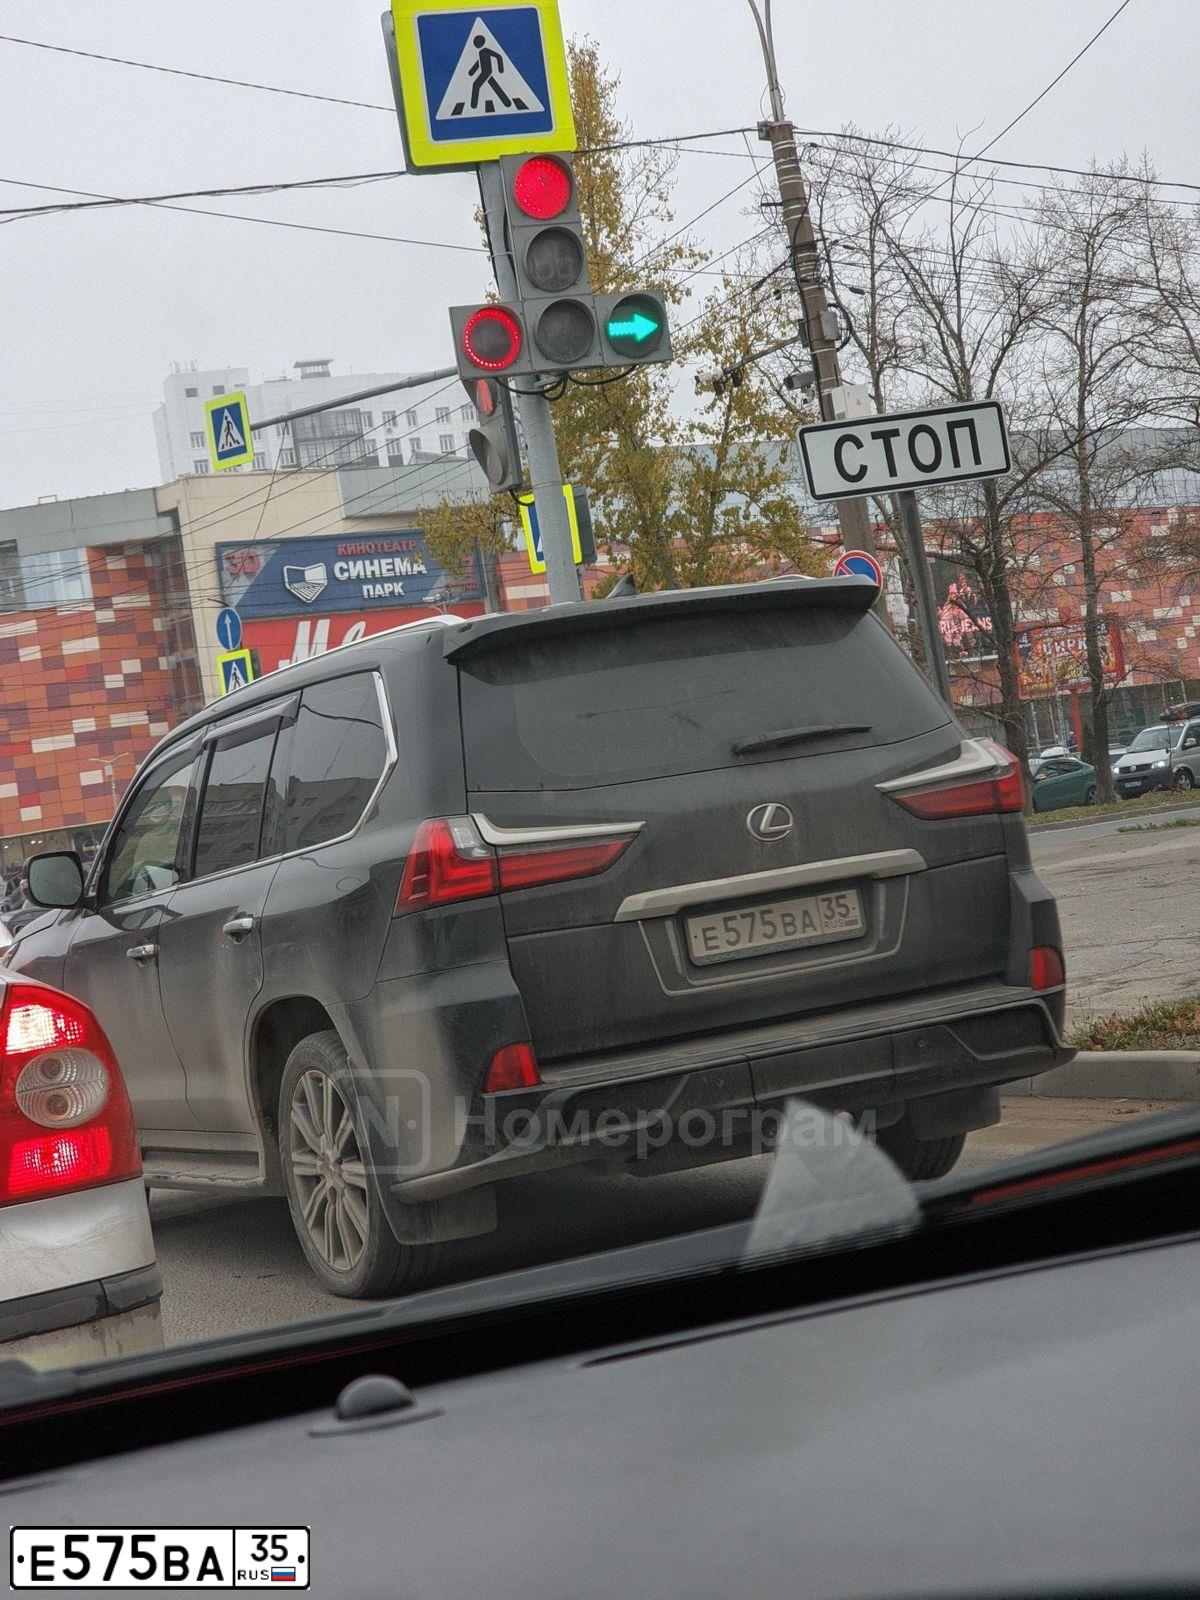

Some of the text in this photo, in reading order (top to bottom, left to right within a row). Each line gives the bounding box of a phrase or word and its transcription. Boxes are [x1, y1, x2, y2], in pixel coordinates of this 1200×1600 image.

[834, 418, 982, 483] СТОП
[337, 540, 417, 557] КИНОТЕАТР
[334, 557, 428, 580] СИНЕМА
[362, 582, 405, 598] ПАРК
[702, 894, 850, 951] Е575ВА 35
[823, 919, 845, 930] RUS
